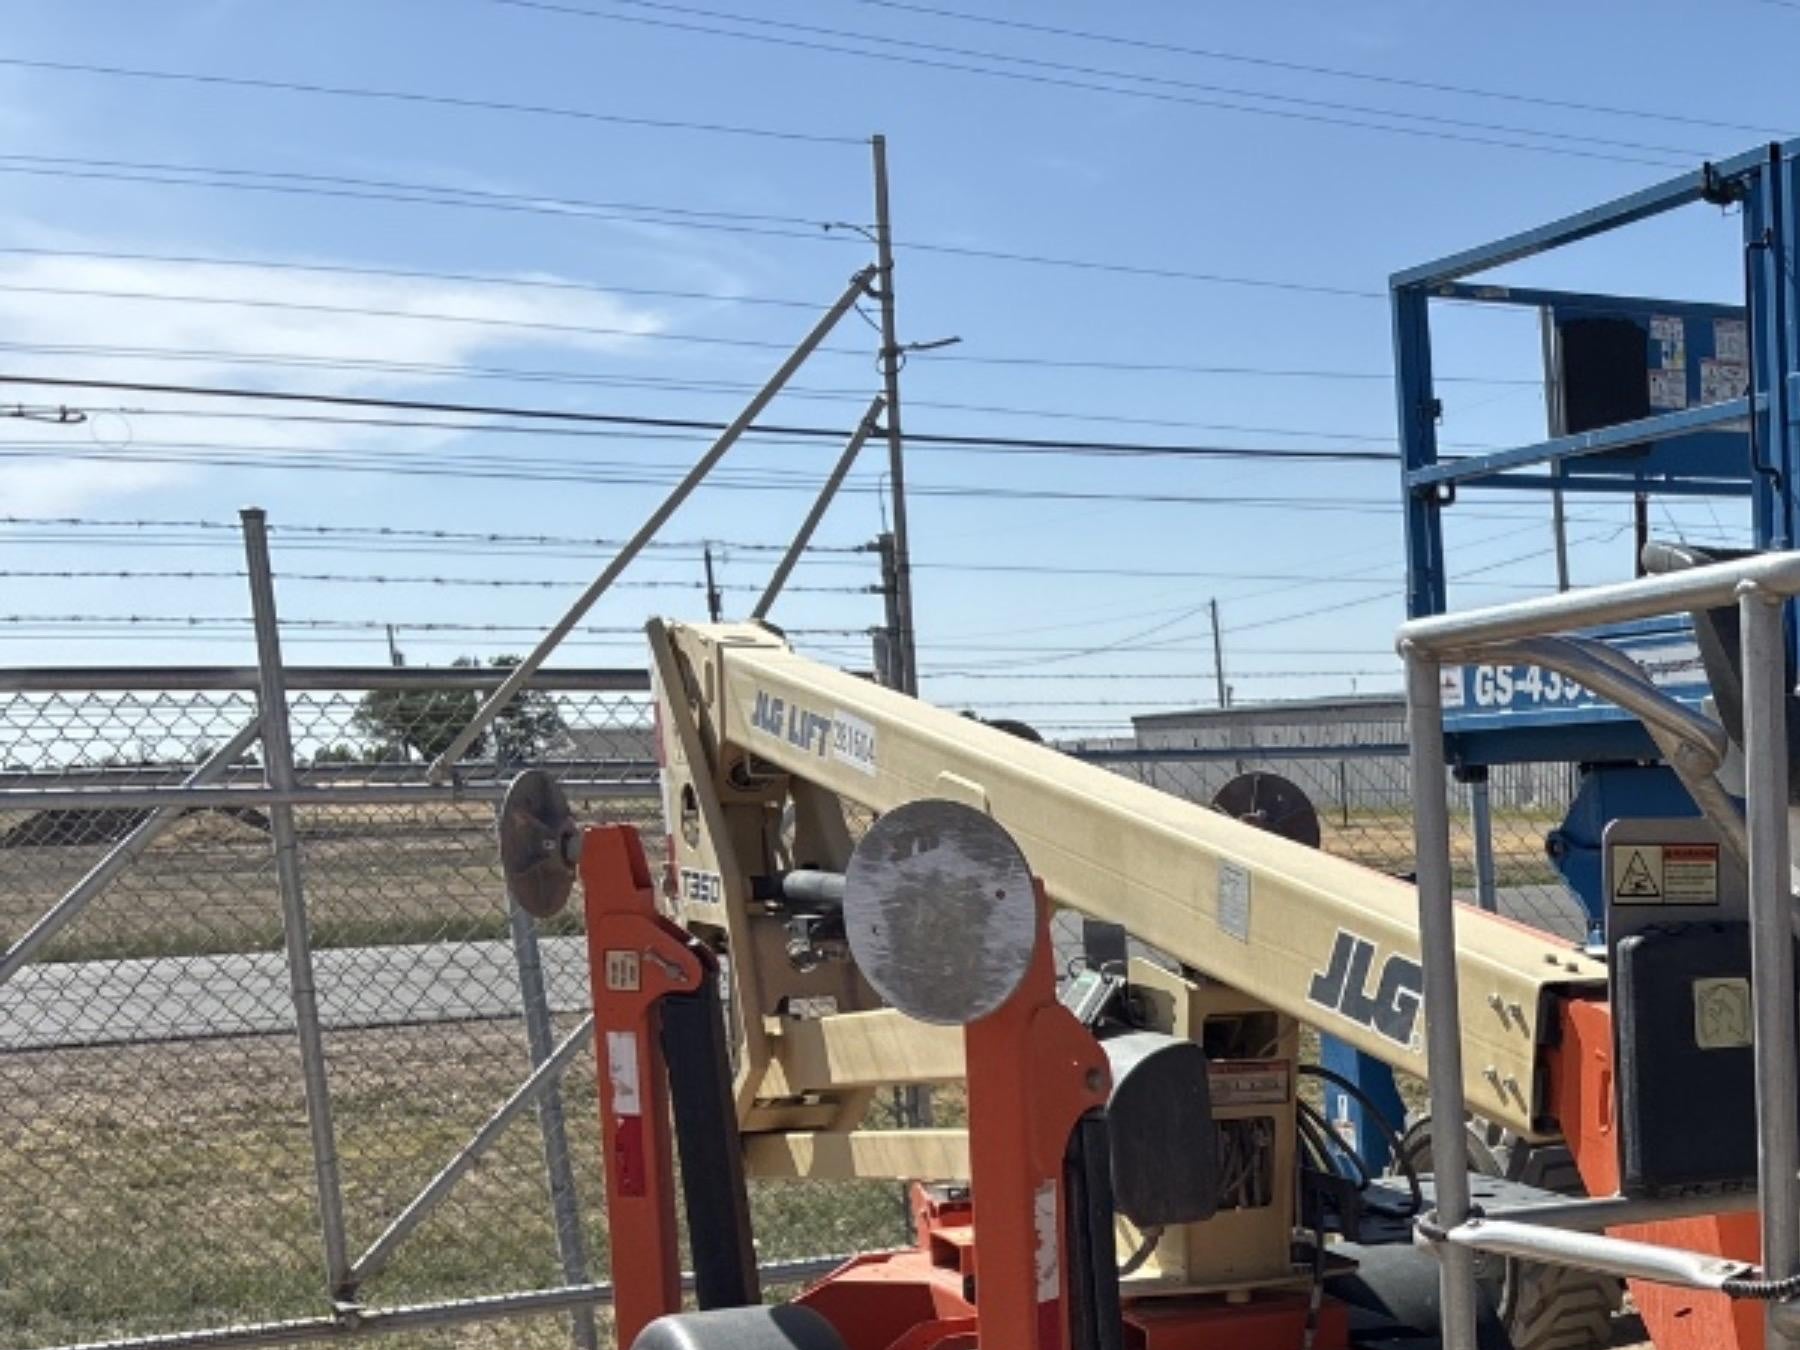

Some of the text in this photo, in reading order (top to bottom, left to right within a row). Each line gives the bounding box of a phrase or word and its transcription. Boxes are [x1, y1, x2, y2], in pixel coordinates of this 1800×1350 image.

[751, 689, 832, 757] JLG LIFT
[1305, 927, 1424, 1049] JLG
